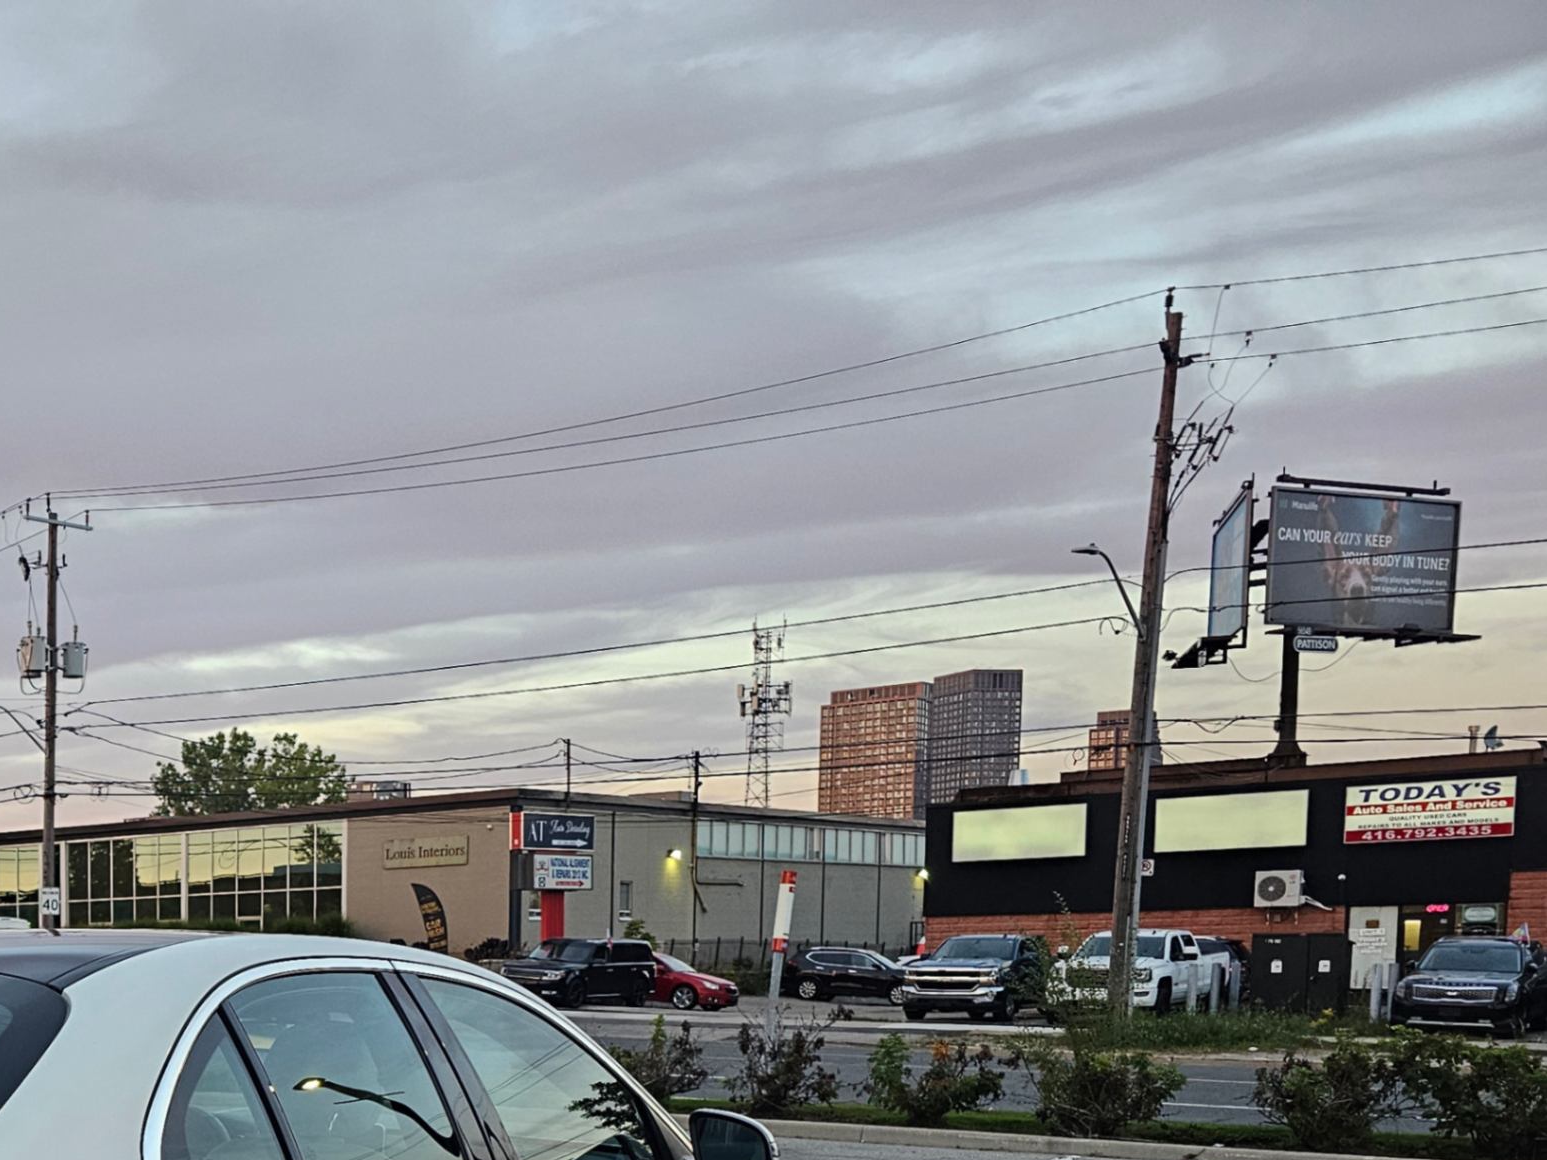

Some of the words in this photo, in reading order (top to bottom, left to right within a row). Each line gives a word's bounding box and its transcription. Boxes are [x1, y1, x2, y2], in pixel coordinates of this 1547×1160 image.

[1278, 527, 1301, 541] CAN
[1303, 529, 1331, 544] YOUR
[1333, 532, 1362, 546] ears
[1365, 534, 1393, 547] KEEP
[1342, 551, 1371, 566] YOUR
[1373, 554, 1401, 568] BODY
[1403, 556, 1414, 568] IN
[1417, 557, 1450, 571] TUNE?
[1296, 639, 1336, 650] PATTISON
[1359, 782, 1502, 802] TODAY'S
[1353, 805, 1384, 815] Auto
[1386, 803, 1423, 813] Sales
[1426, 801, 1452, 811] And
[1456, 799, 1508, 809] Service
[1388, 814, 1422, 822] QUALITY
[1361, 825, 1493, 840] 416.792.3435
[385, 846, 416, 861] Louis
[418, 843, 466, 859] Interiors
[42, 898, 59, 911] 40
